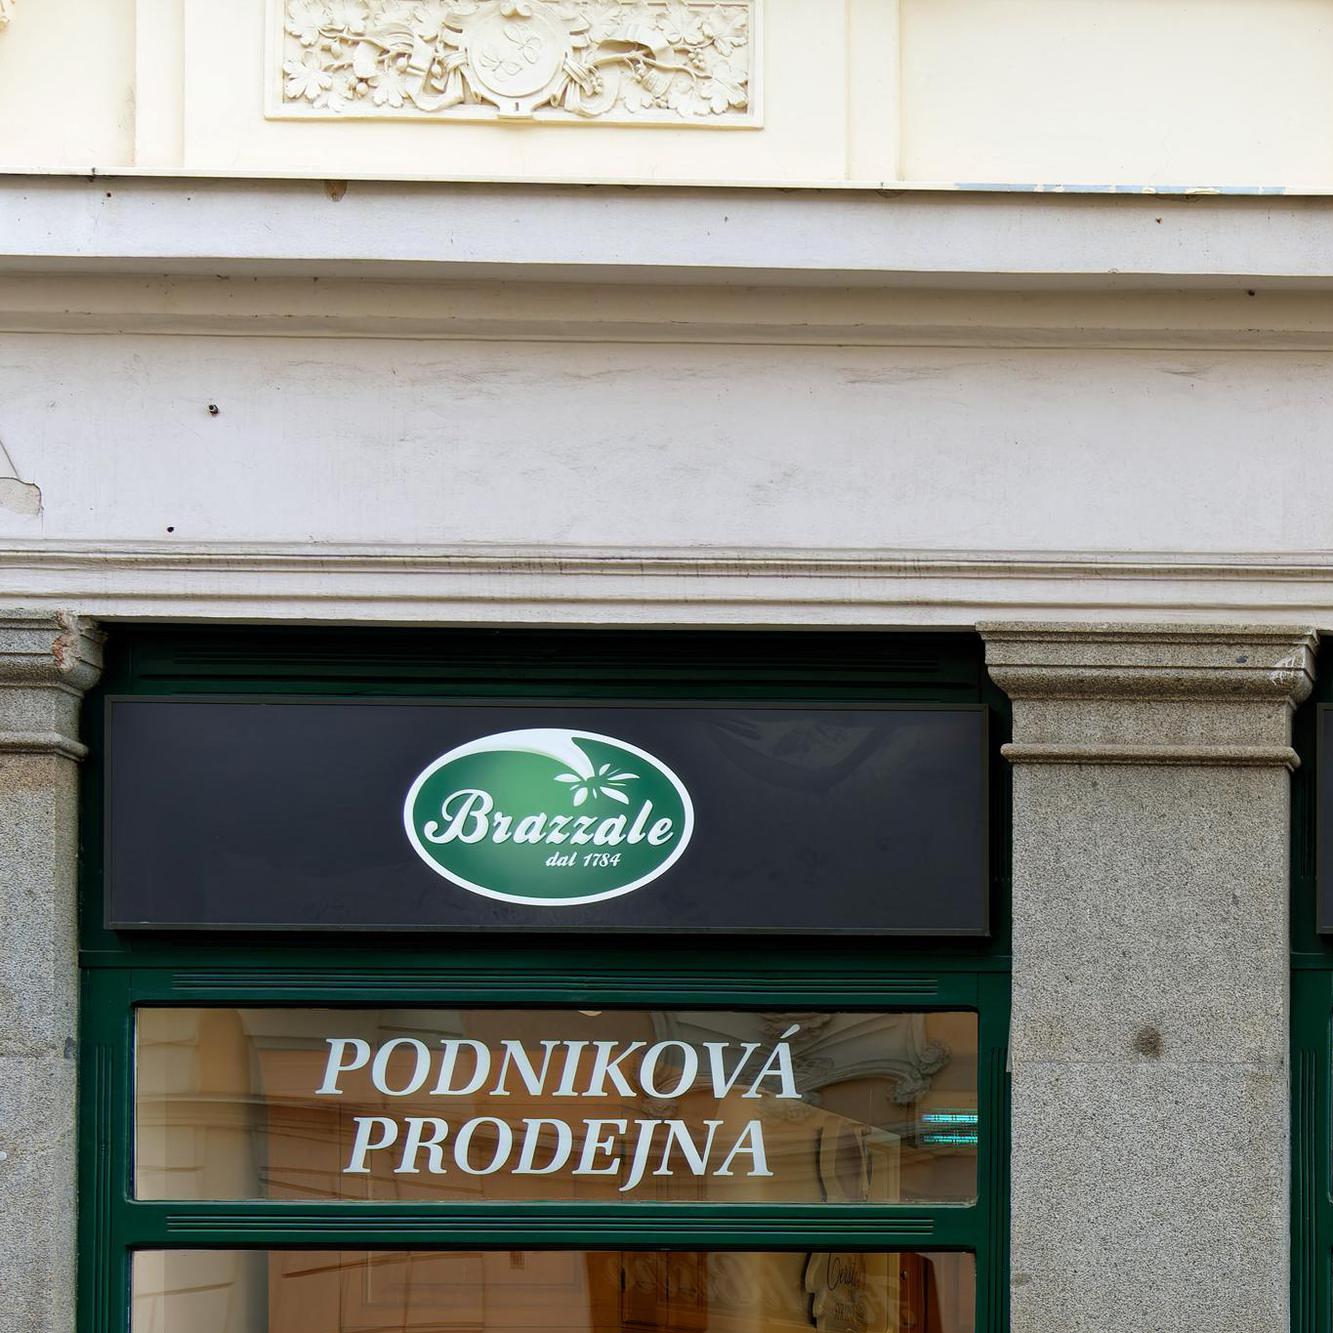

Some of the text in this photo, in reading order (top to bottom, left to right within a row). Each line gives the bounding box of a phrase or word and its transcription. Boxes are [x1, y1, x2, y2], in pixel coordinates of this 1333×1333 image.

[425, 789, 674, 849] Brazzale
[546, 849, 621, 868] dal 1784
[315, 1026, 802, 1099] PODNIKOVÁ
[343, 1117, 775, 1192] PRODEJNA
